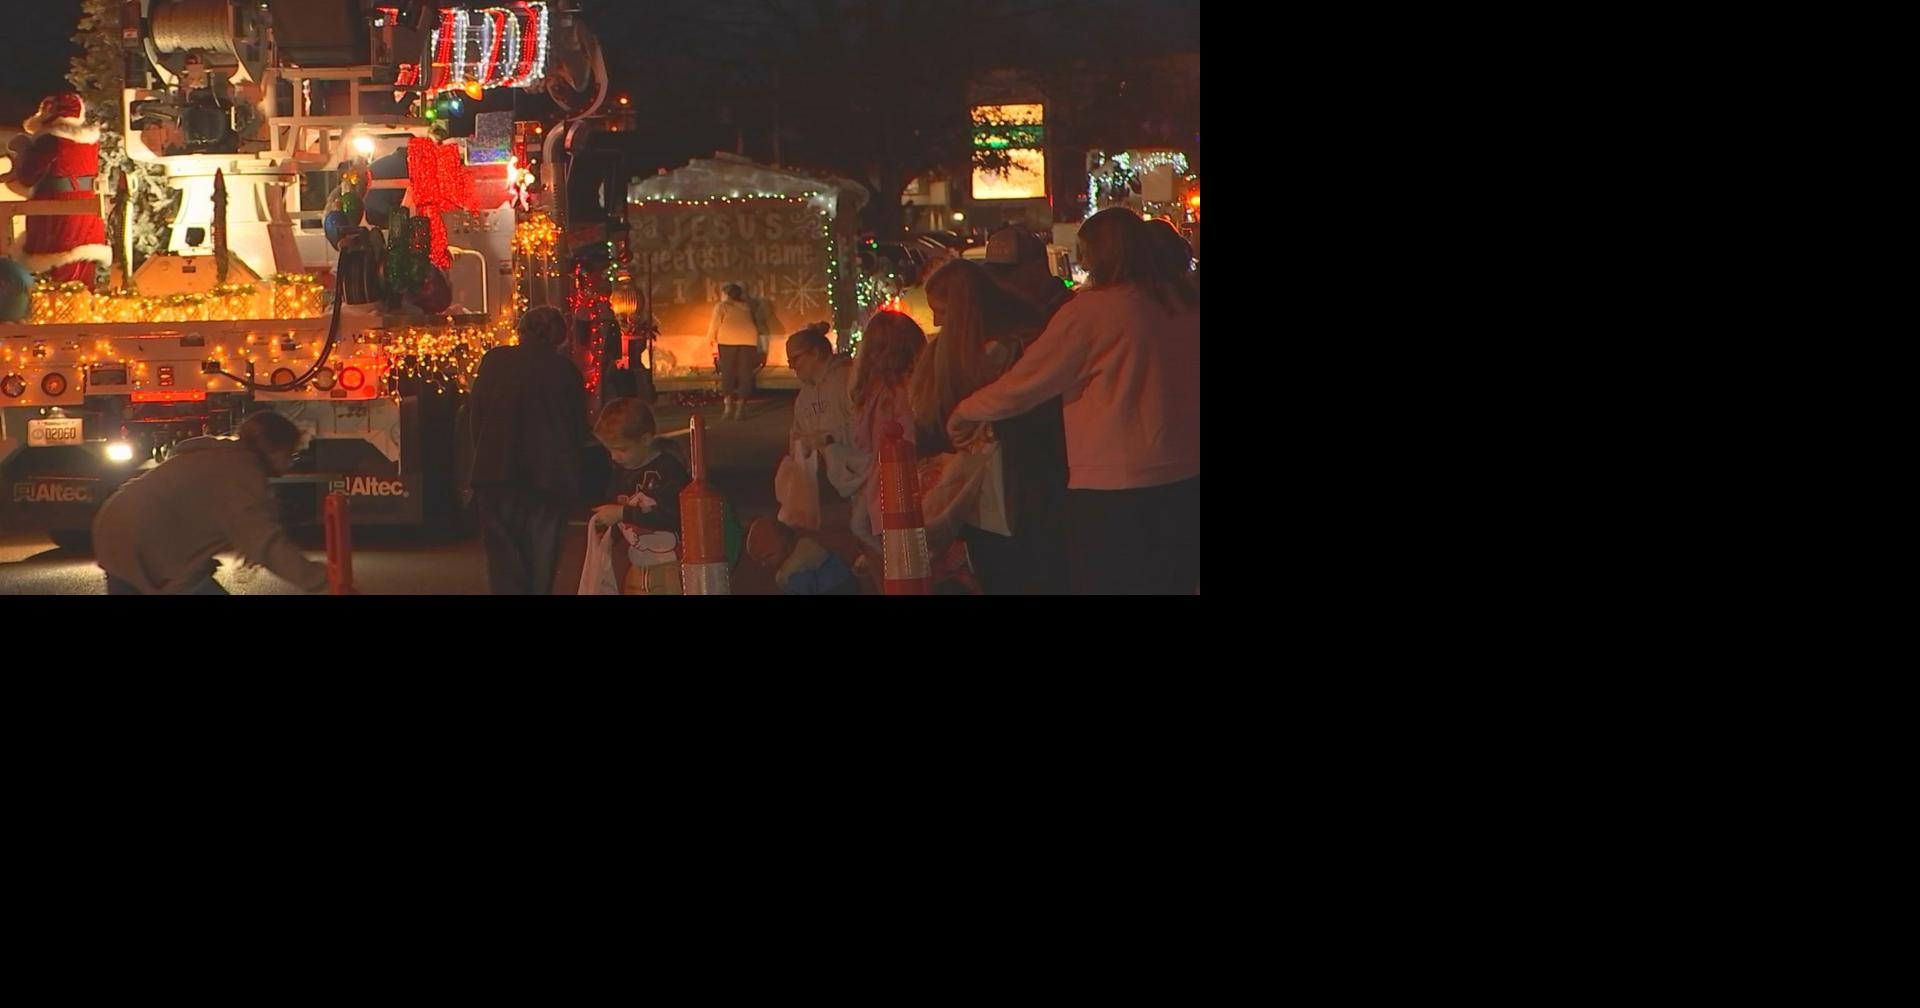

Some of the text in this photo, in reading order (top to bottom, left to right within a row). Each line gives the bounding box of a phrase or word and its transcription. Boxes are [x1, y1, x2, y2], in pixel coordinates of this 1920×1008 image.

[668, 213, 783, 242] JESUS
[754, 244, 816, 265] name
[351, 477, 404, 496] Altec
